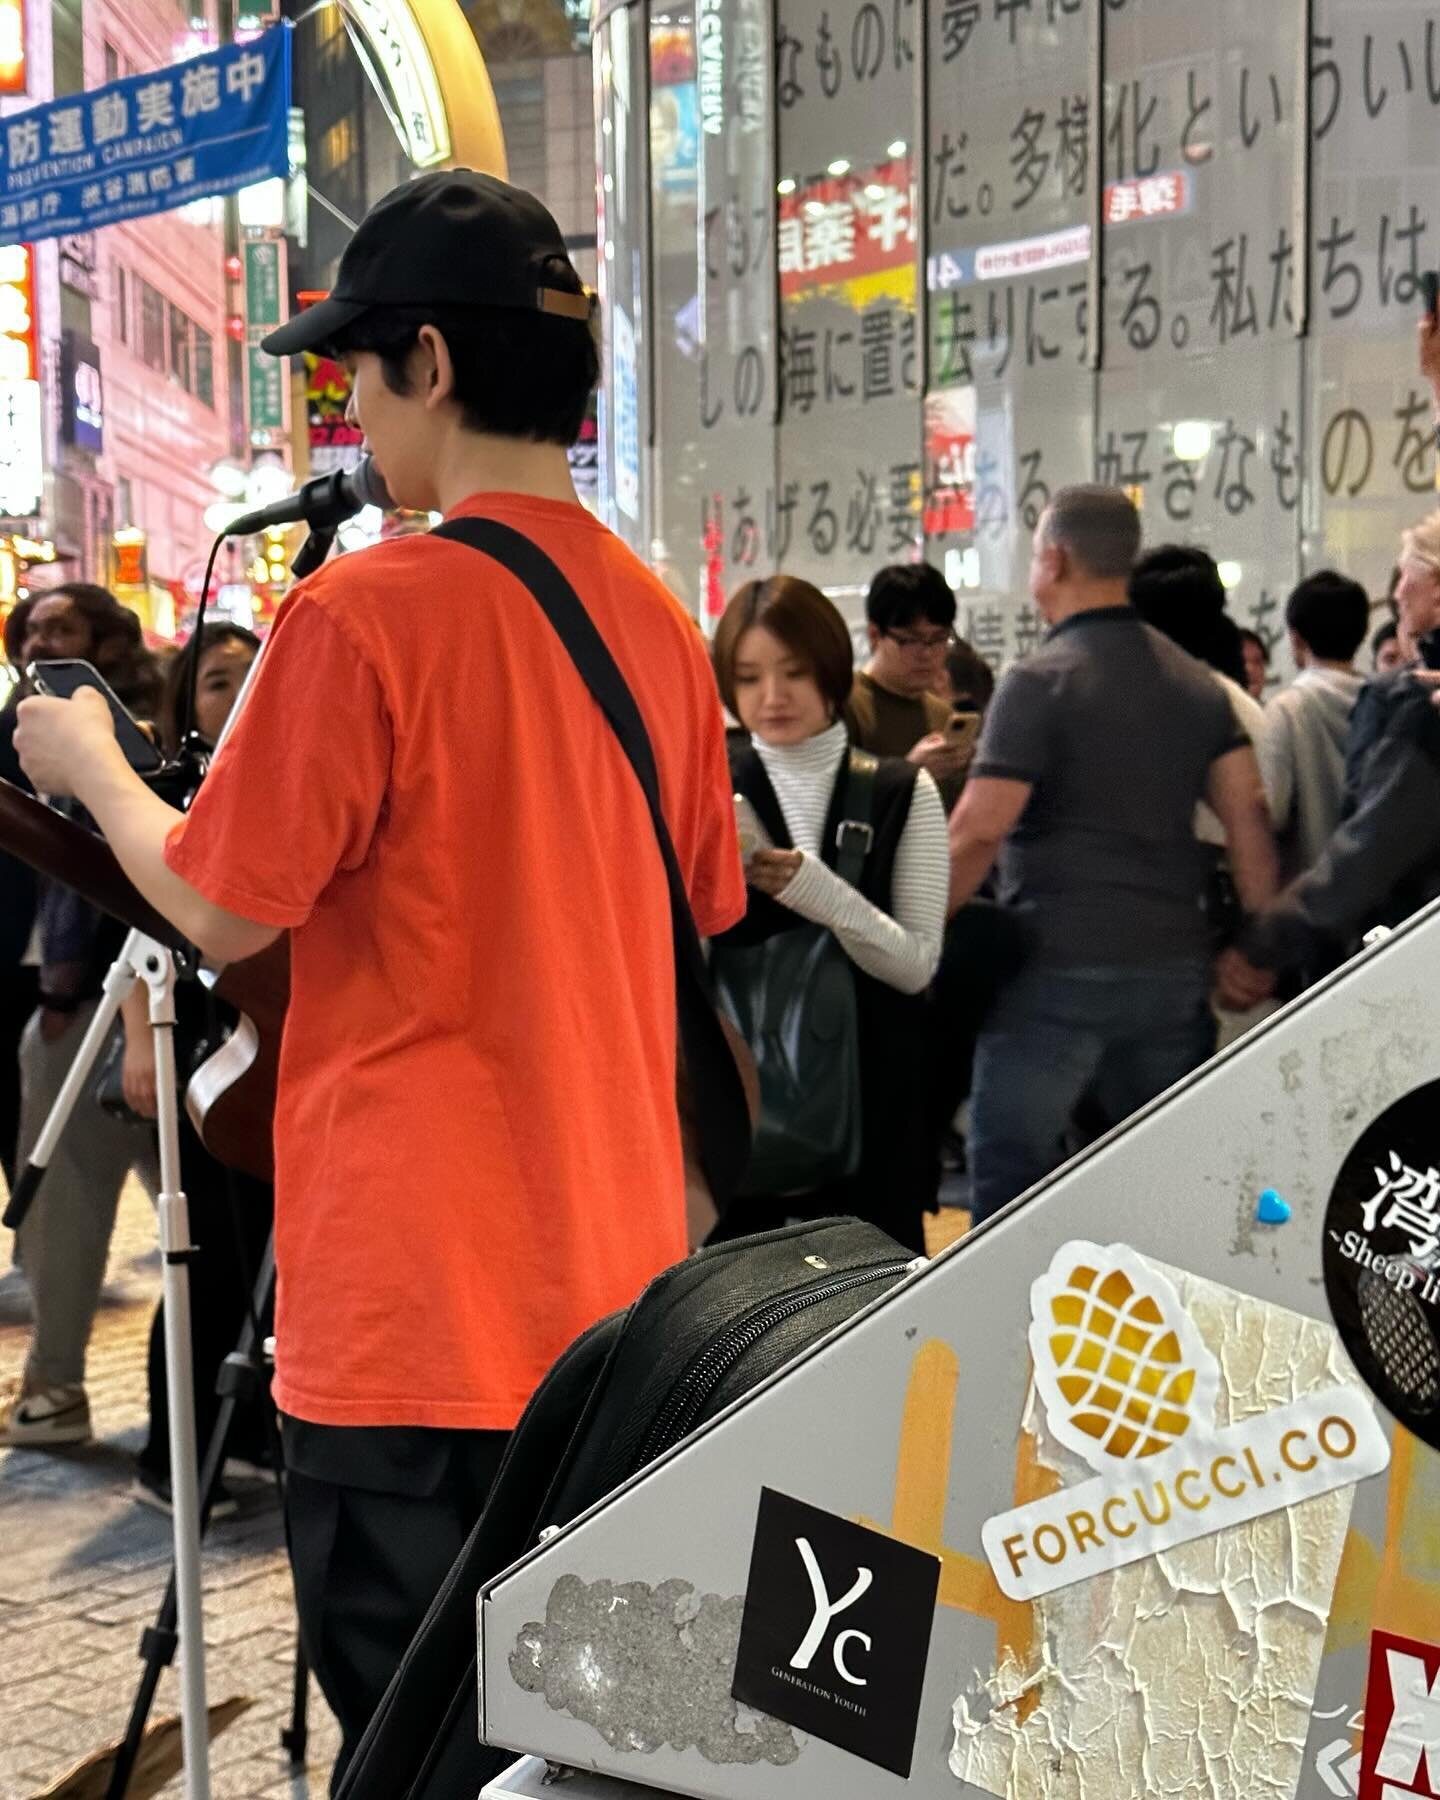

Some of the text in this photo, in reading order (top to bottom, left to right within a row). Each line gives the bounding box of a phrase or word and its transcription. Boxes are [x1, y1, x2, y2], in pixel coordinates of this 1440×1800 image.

[0, 52, 266, 168] 防運動実施中
[1001, 1415, 1357, 1578] FORCUCCI.CO
